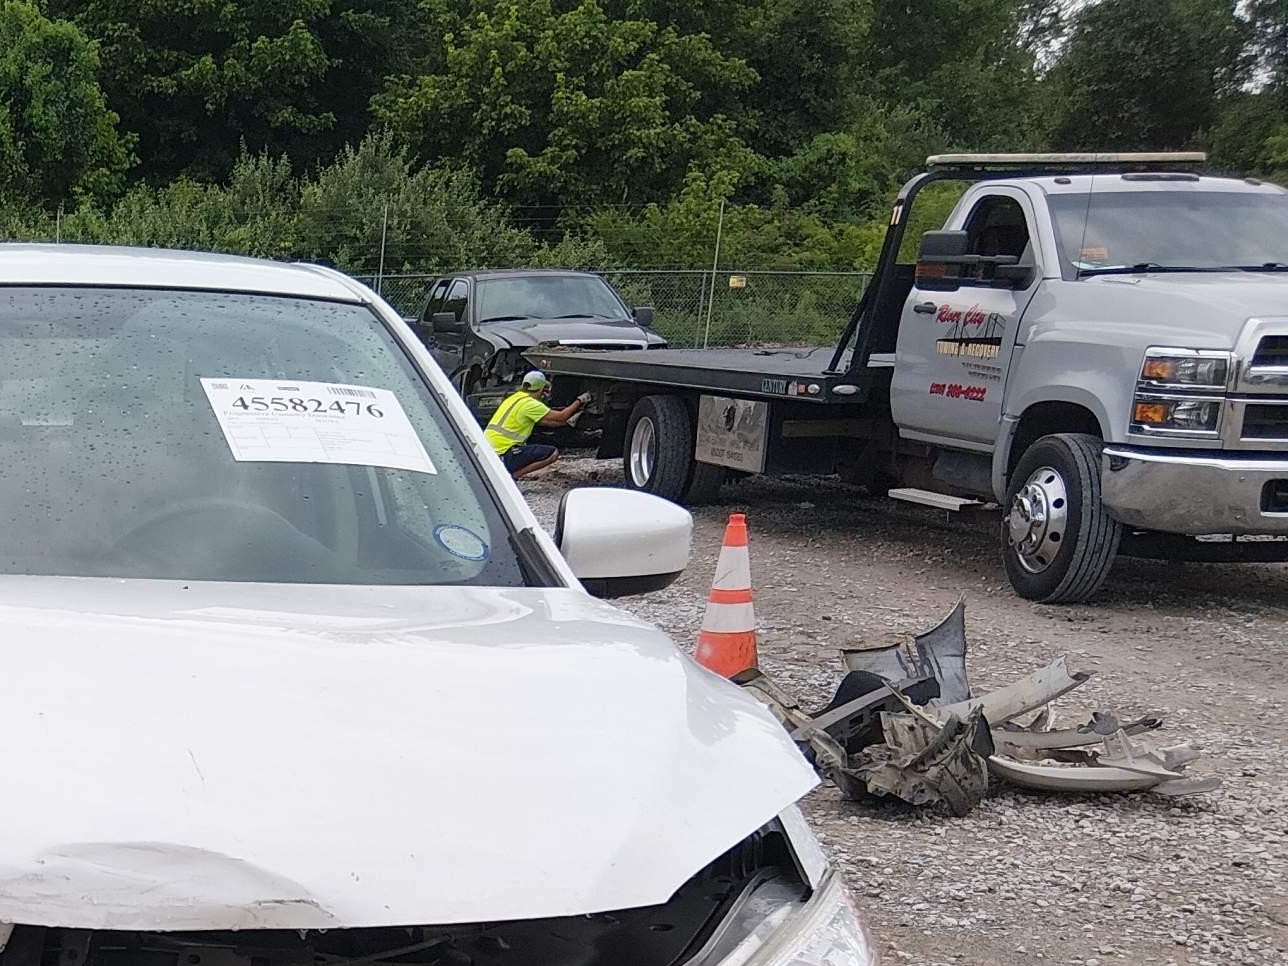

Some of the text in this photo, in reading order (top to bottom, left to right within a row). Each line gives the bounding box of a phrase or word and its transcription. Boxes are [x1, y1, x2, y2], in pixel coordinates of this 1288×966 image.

[963, 303, 985, 329] City
[967, 342, 1000, 358] RECOVERY
[762, 378, 787, 394] CENTURY
[232, 396, 384, 418] 45582476
